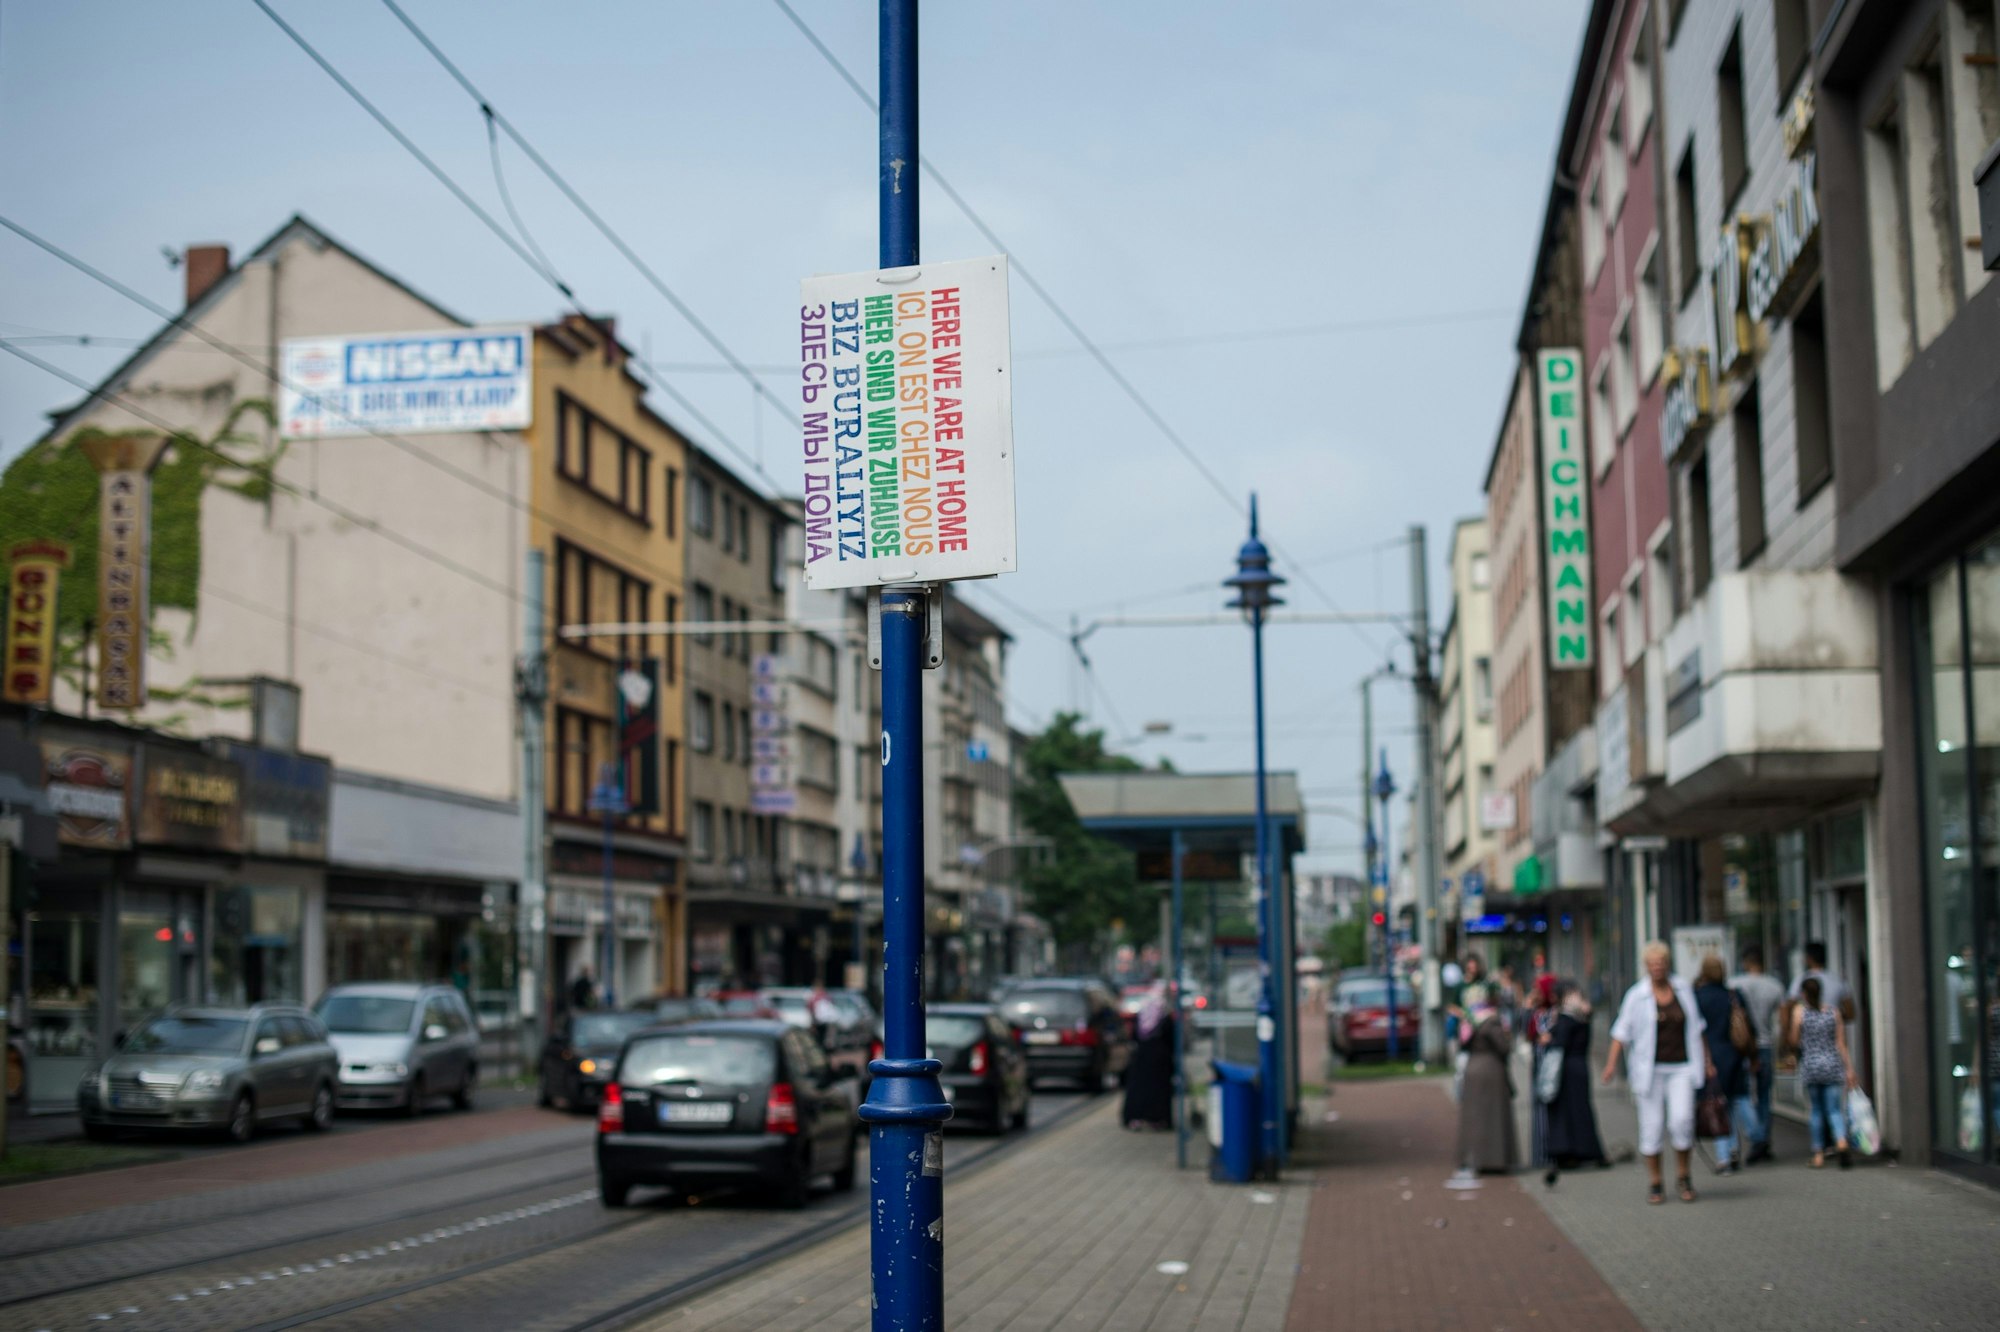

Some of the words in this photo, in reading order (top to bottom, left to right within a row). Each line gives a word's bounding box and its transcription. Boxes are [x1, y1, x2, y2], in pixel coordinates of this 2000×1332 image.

[831, 298, 863, 356] BİZ
[864, 294, 893, 345] HIER
[895, 291, 926, 327] ICI,
[931, 287, 961, 350] HERE
[349, 338, 518, 380] NISSAN
[800, 303, 828, 404] ЗДЕСЬ
[865, 349, 896, 402] SIND
[897, 331, 927, 368] ON
[932, 351, 962, 391] WE
[899, 373, 928, 414] EST
[933, 396, 964, 443] ARE
[802, 411, 830, 464] МЫ
[867, 406, 897, 453] WIR
[900, 420, 930, 482] CHEZ
[832, 364, 867, 562] BURALIYIZ
[935, 447, 965, 474] AT
[804, 472, 833, 564] ДОМА
[868, 457, 901, 558] ZUHAUSE
[902, 487, 934, 556] NOUS
[936, 479, 968, 554] HOME
[1547, 357, 1586, 661] DEICHMANN
